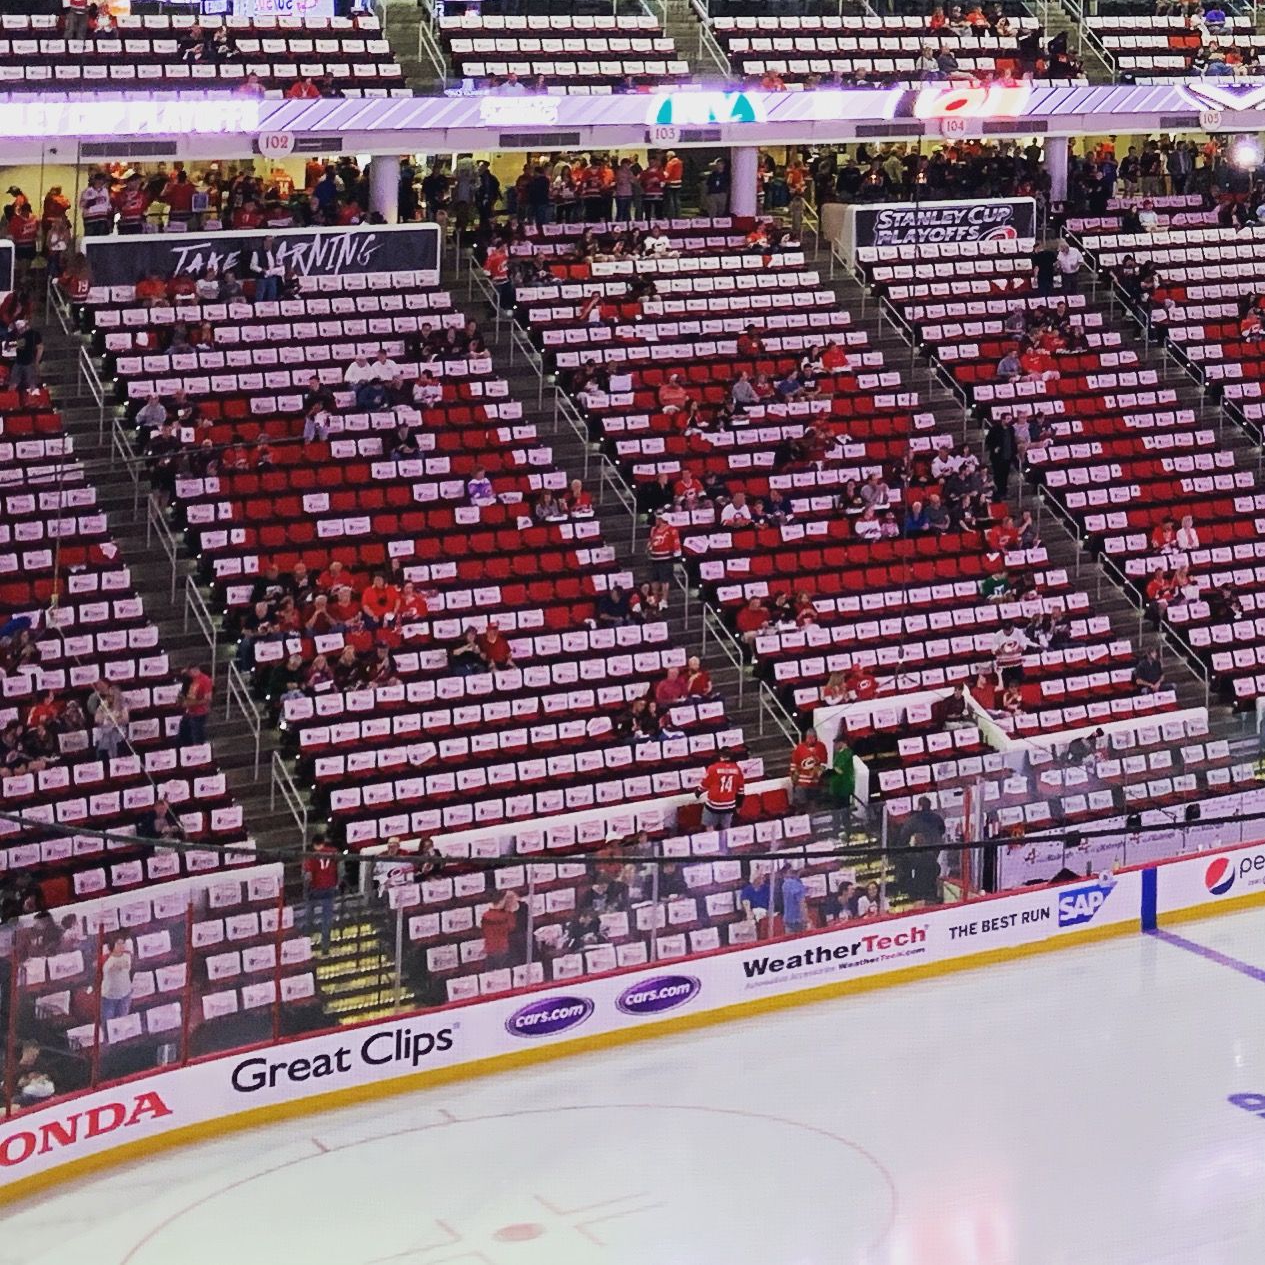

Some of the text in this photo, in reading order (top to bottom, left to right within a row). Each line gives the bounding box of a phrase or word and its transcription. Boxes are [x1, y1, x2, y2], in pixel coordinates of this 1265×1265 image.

[945, 120, 965, 133] 104
[1202, 112, 1220, 124] 105
[263, 135, 290, 150] 102
[654, 127, 676, 140] 103
[877, 206, 1012, 230] STANLEY CUP
[876, 225, 980, 245] PLAYOFFS
[170, 242, 241, 276] TAKE
[719, 775, 734, 793] 14
[1059, 891, 1104, 922] SAP
[949, 906, 1051, 940] THE BEST RUN
[743, 927, 927, 978] WeatherTech
[625, 982, 692, 1007] cars.com
[514, 1002, 584, 1028] cars.com
[230, 1025, 454, 1093] Great Clips
[0, 1091, 174, 1168] ONDA
